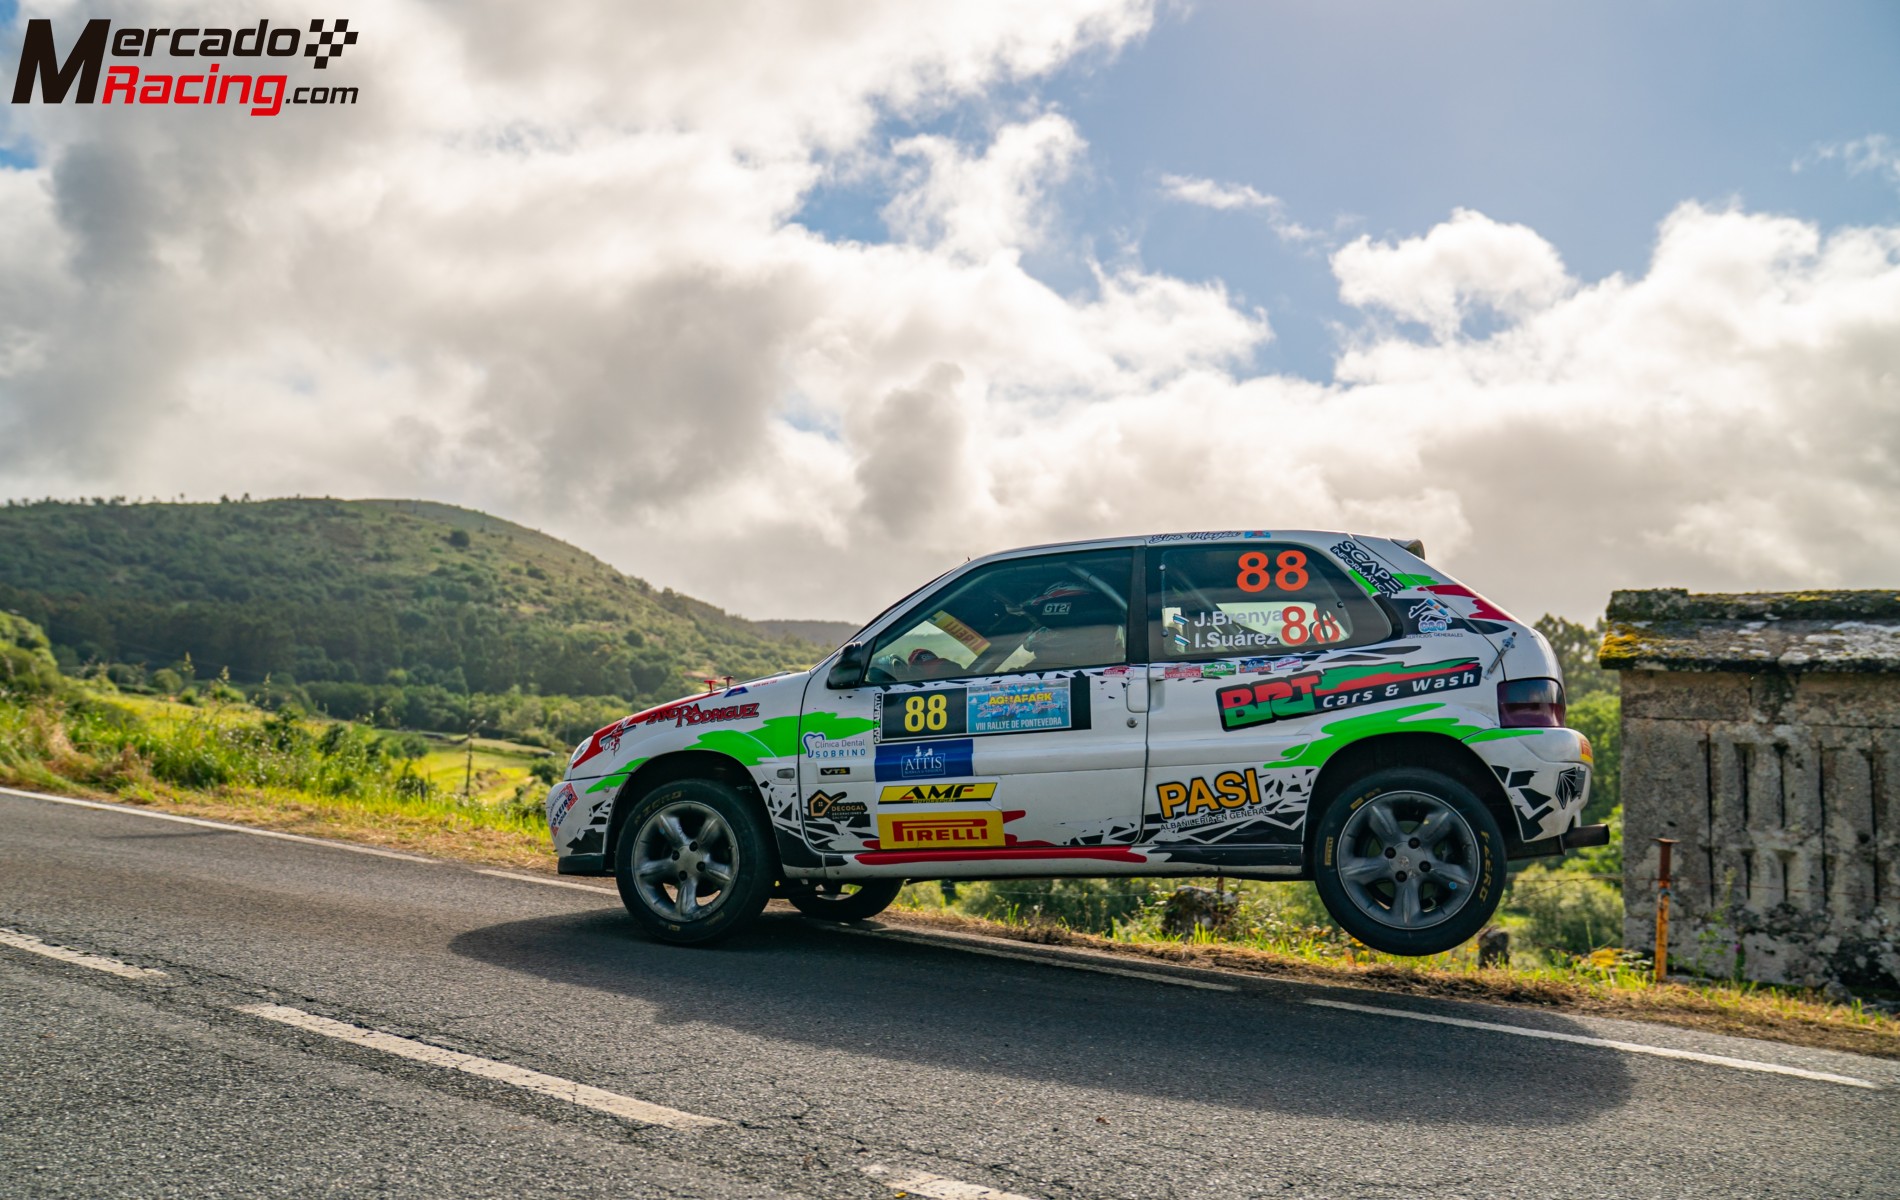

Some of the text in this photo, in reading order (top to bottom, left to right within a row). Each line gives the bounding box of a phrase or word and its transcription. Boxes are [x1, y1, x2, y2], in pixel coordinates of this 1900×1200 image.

[1236, 550, 1309, 593] 88
[1338, 541, 1404, 593] SCAPE
[1194, 609, 1284, 627] J.Brenya
[1195, 629, 1278, 648] I.Suárez
[1322, 691, 1373, 708] Cars
[1385, 684, 1400, 696] &
[1412, 671, 1476, 692] Wash
[904, 694, 948, 733] 88
[975, 717, 1063, 731] VIII RALLYE DE PONTEVEDRA
[841, 739, 865, 748] Dental
[815, 748, 866, 758] SOBRINO
[905, 756, 943, 771] ATTIS
[899, 784, 976, 800] AMF
[1157, 768, 1262, 819] PASI
[831, 804, 865, 812] DECOGAL
[1215, 813, 1228, 822] EN
[1229, 807, 1270, 820] GENERAL
[891, 818, 988, 843] PIRELLI
